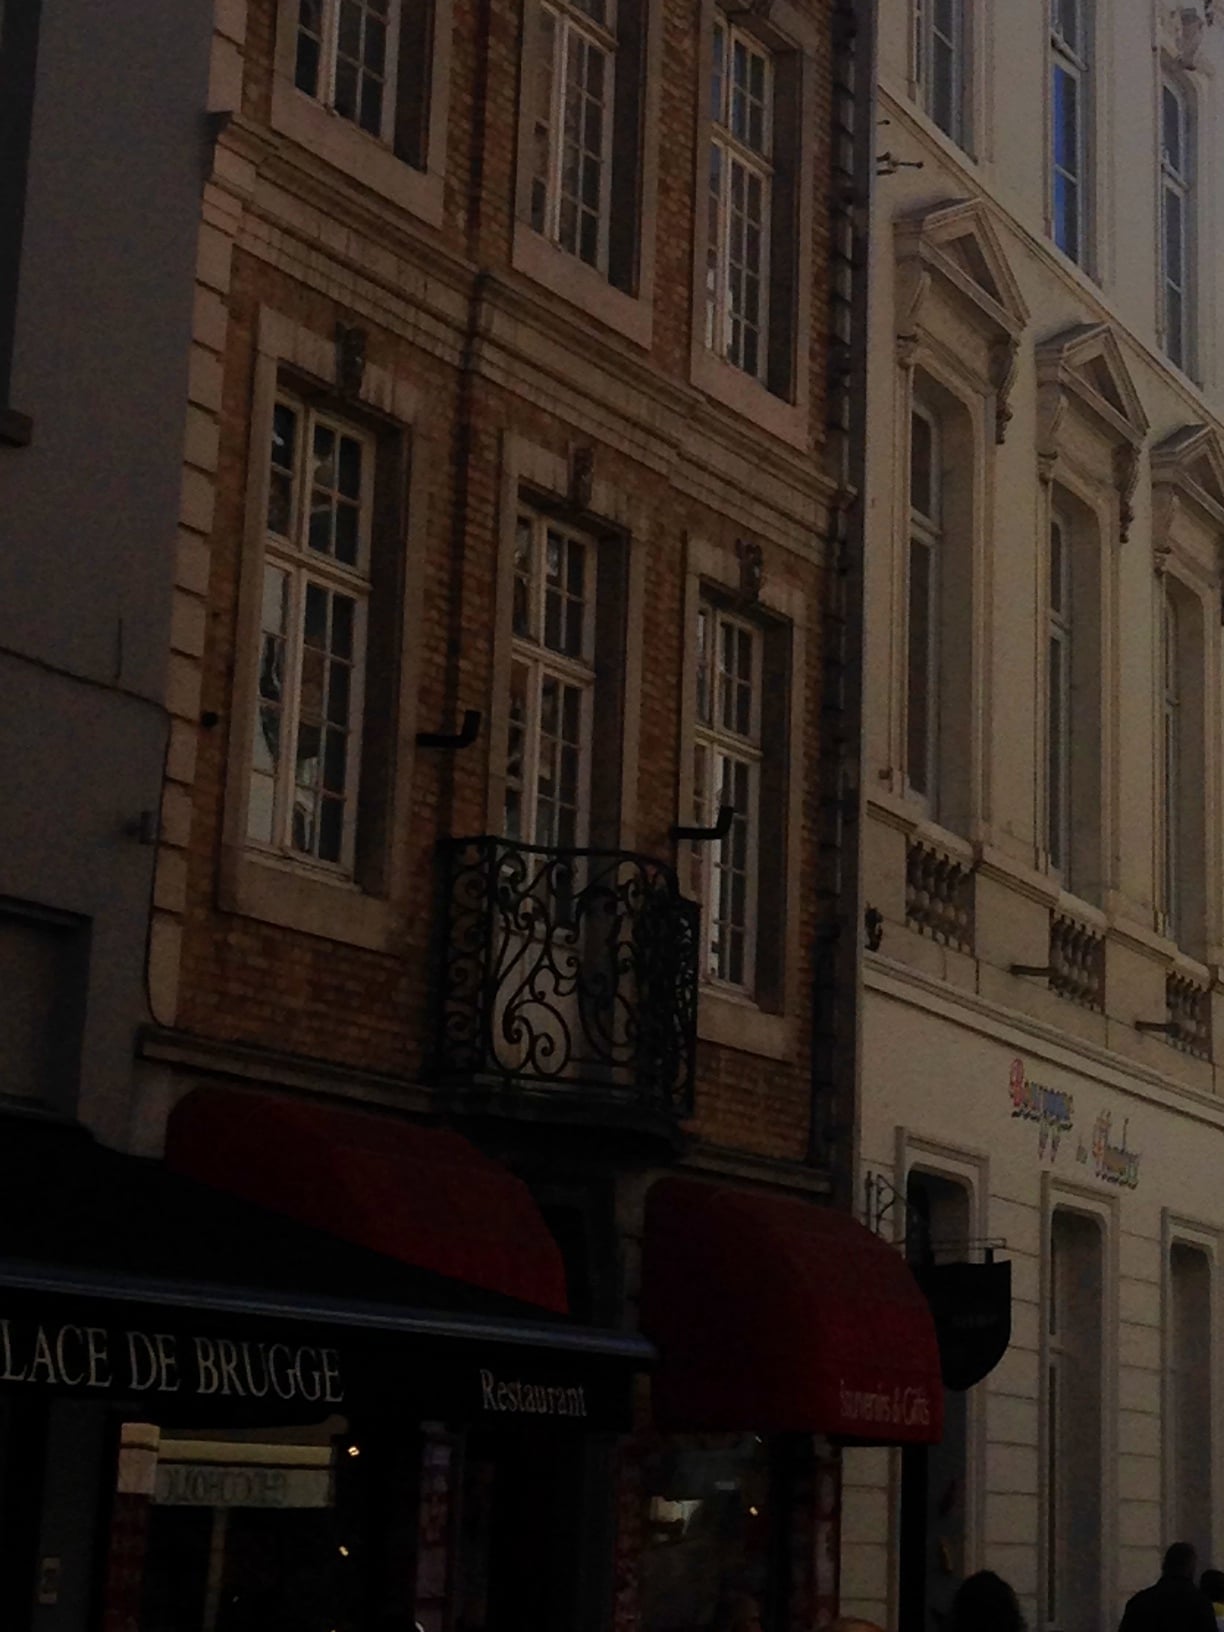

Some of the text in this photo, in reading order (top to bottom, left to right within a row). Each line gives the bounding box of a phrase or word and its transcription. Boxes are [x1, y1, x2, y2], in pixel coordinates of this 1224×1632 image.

[0, 1319, 345, 1403] LACE DE BRUGGE
[479, 1368, 588, 1417] Restaurant
